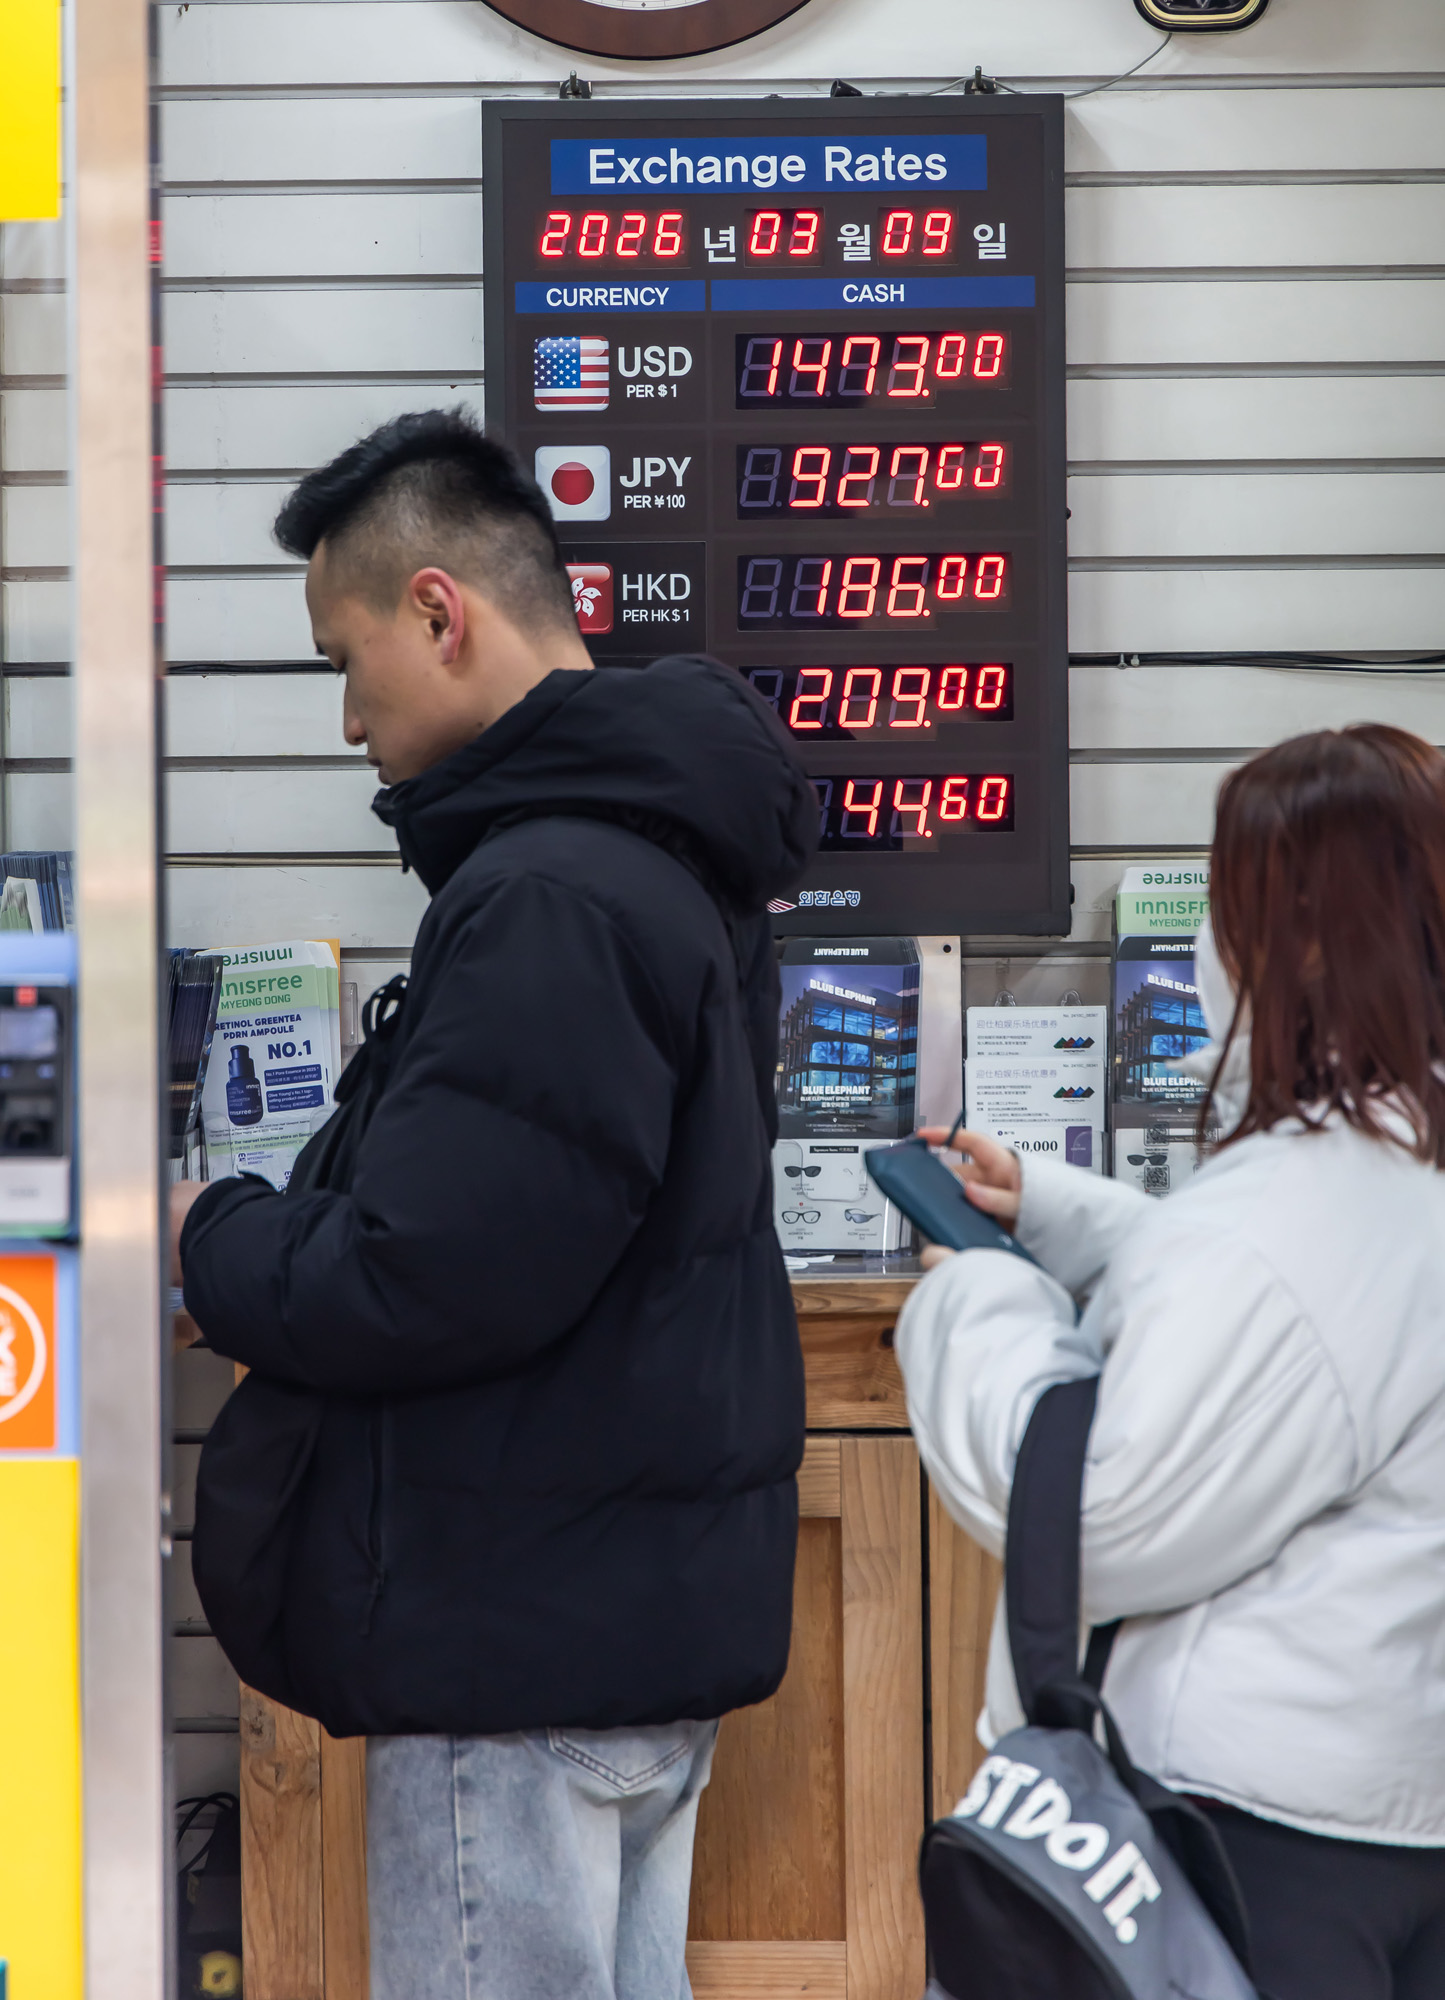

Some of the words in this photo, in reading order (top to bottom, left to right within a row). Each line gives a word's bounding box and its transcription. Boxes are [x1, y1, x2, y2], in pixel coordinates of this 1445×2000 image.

[589, 148, 806, 188] Exchange
[825, 146, 947, 181] Rates
[540, 212, 684, 257] 2026
[704, 226, 736, 262] 년
[750, 212, 819, 256] 03
[837, 223, 871, 261] 월
[882, 211, 952, 256] 09
[973, 223, 1006, 259] 일
[546, 287, 669, 306] CURRENCY
[842, 284, 905, 303] CASH
[618, 345, 692, 378] USD
[627, 385, 654, 398] PER
[620, 457, 691, 487] JPY
[624, 495, 652, 508] PER
[622, 573, 691, 601] HKD
[623, 609, 648, 622] PER
[799, 890, 860, 907] 외환은행
[1149, 919, 1192, 927] MYEONG
[814, 948, 850, 956] ELEPHANT
[851, 948, 869, 956] BLUE
[809, 978, 834, 994] BLUE
[834, 986, 877, 1006] ELEPHANT
[1147, 973, 1173, 989] BLUE
[1174, 981, 1199, 995] ELEP
[221, 997, 261, 1010] MYEONG
[264, 994, 291, 1006] DONG
[214, 1019, 252, 1031] RETINOL
[255, 1014, 302, 1026] GREENTEA
[223, 1030, 248, 1040] PDRN
[250, 1025, 294, 1037] AMPOULE
[267, 1040, 312, 1060] NO.1
[1143, 1077, 1167, 1086] BLUE
[802, 1086, 824, 1095] BLUE
[825, 1086, 871, 1095] ELEPHANT
[953, 1755, 1041, 1829] ST
